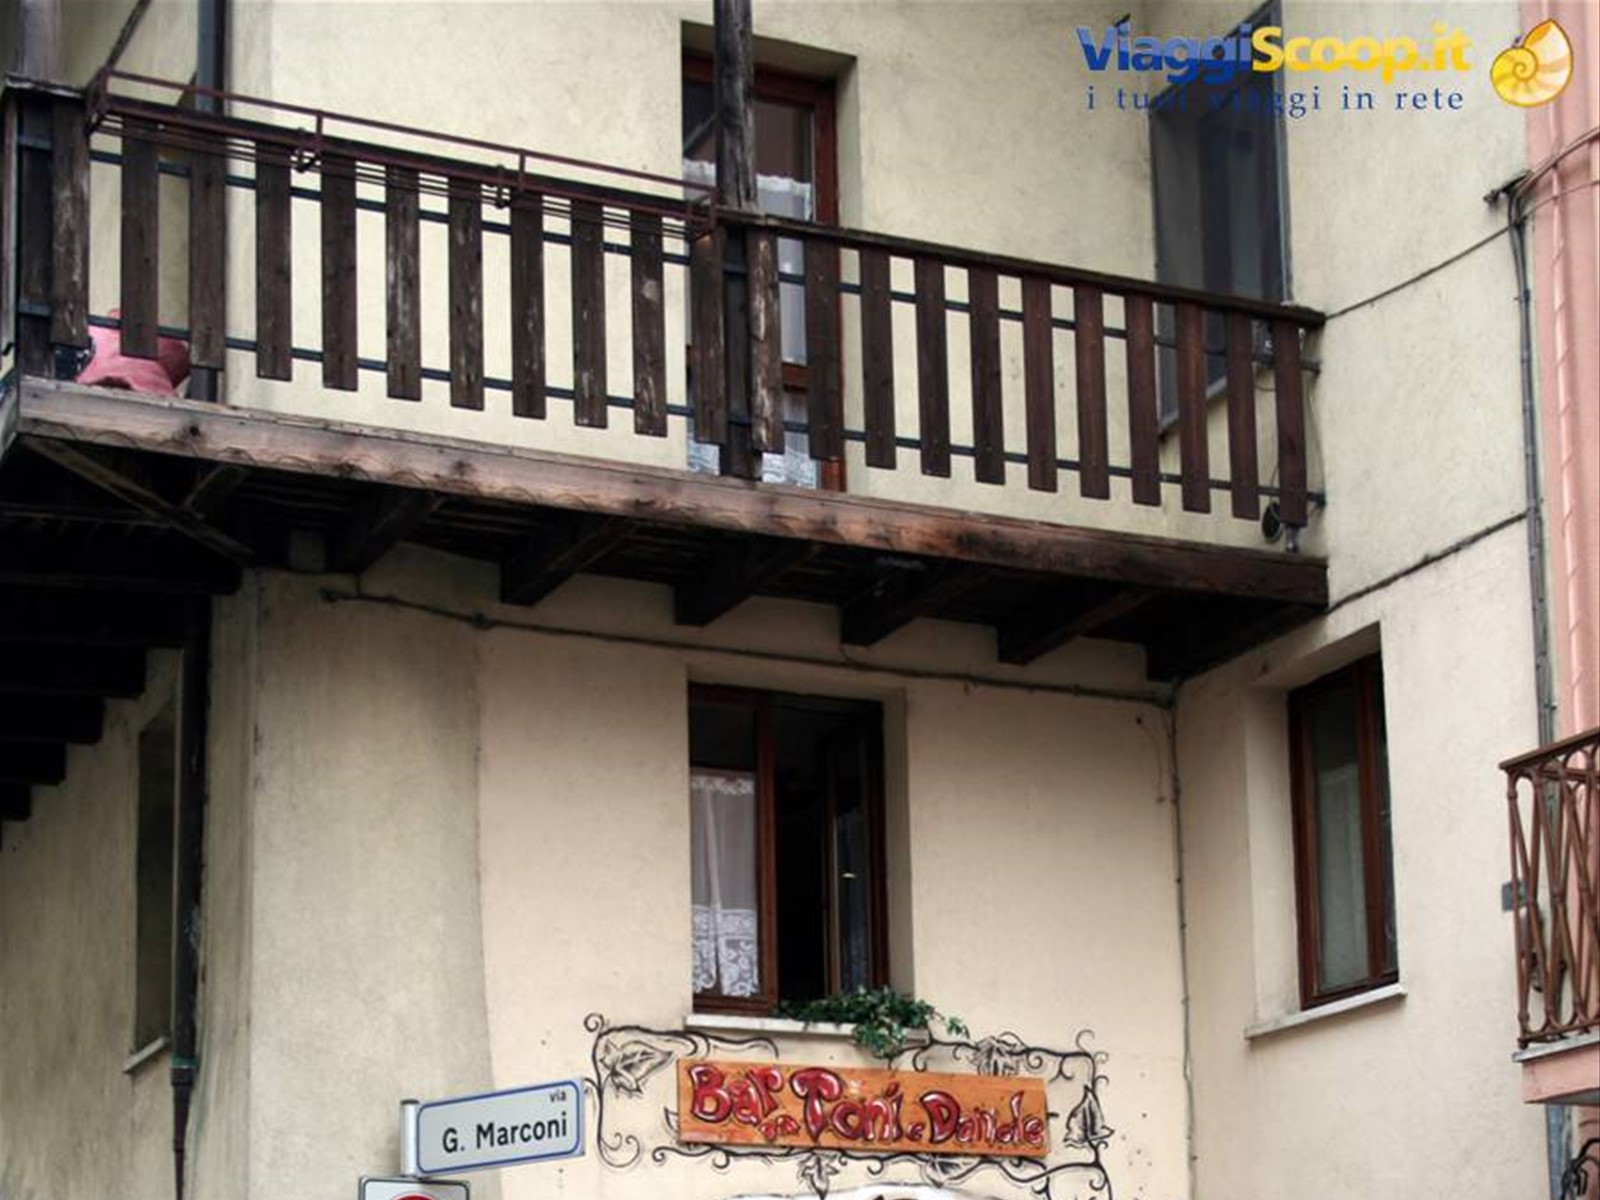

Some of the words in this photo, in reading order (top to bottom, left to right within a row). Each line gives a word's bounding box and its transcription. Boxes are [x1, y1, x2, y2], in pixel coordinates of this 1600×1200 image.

[549, 1089, 567, 1103] via
[688, 1063, 784, 1126] Bar
[789, 1066, 905, 1142] Toni
[442, 1127, 466, 1154] G.
[475, 1110, 568, 1150] Marconi
